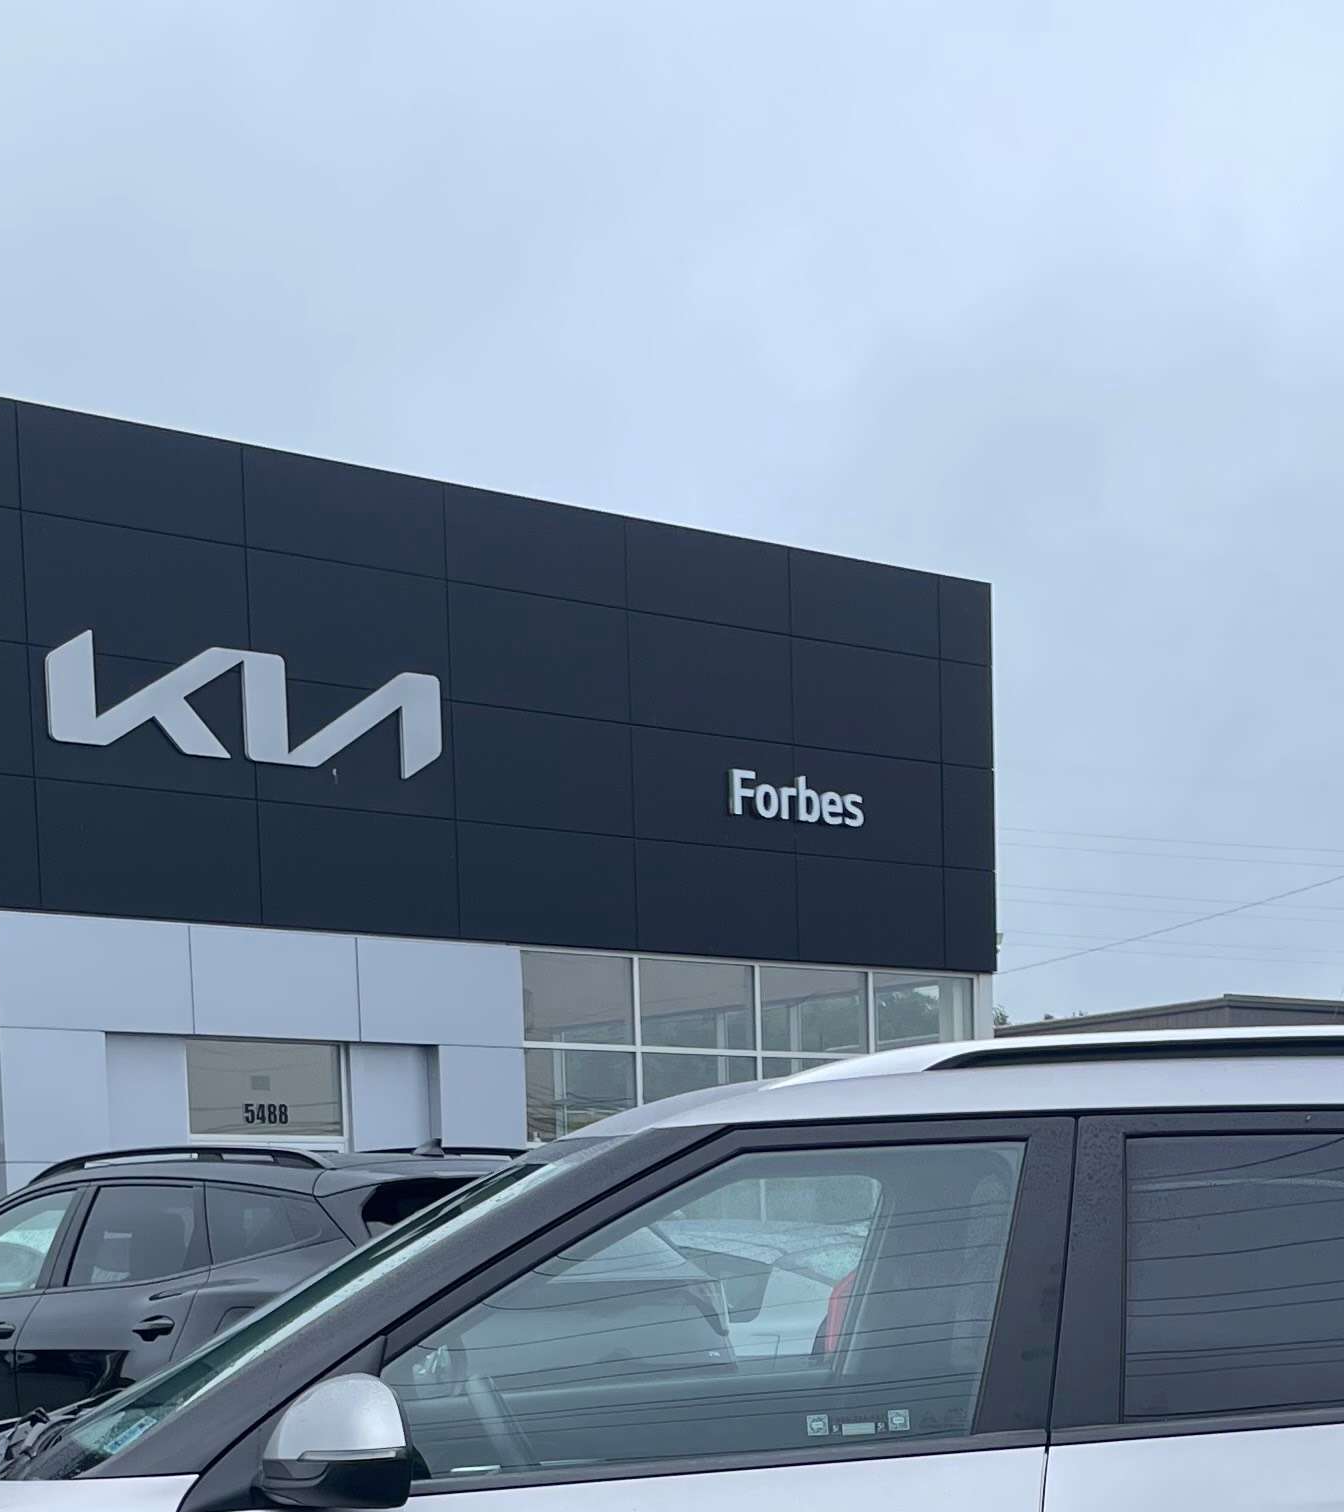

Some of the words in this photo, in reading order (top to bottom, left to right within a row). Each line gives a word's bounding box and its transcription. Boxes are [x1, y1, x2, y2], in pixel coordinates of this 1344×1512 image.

[45, 629, 443, 780] KIA
[729, 768, 865, 828] Forbes
[244, 1103, 289, 1124] 5488
